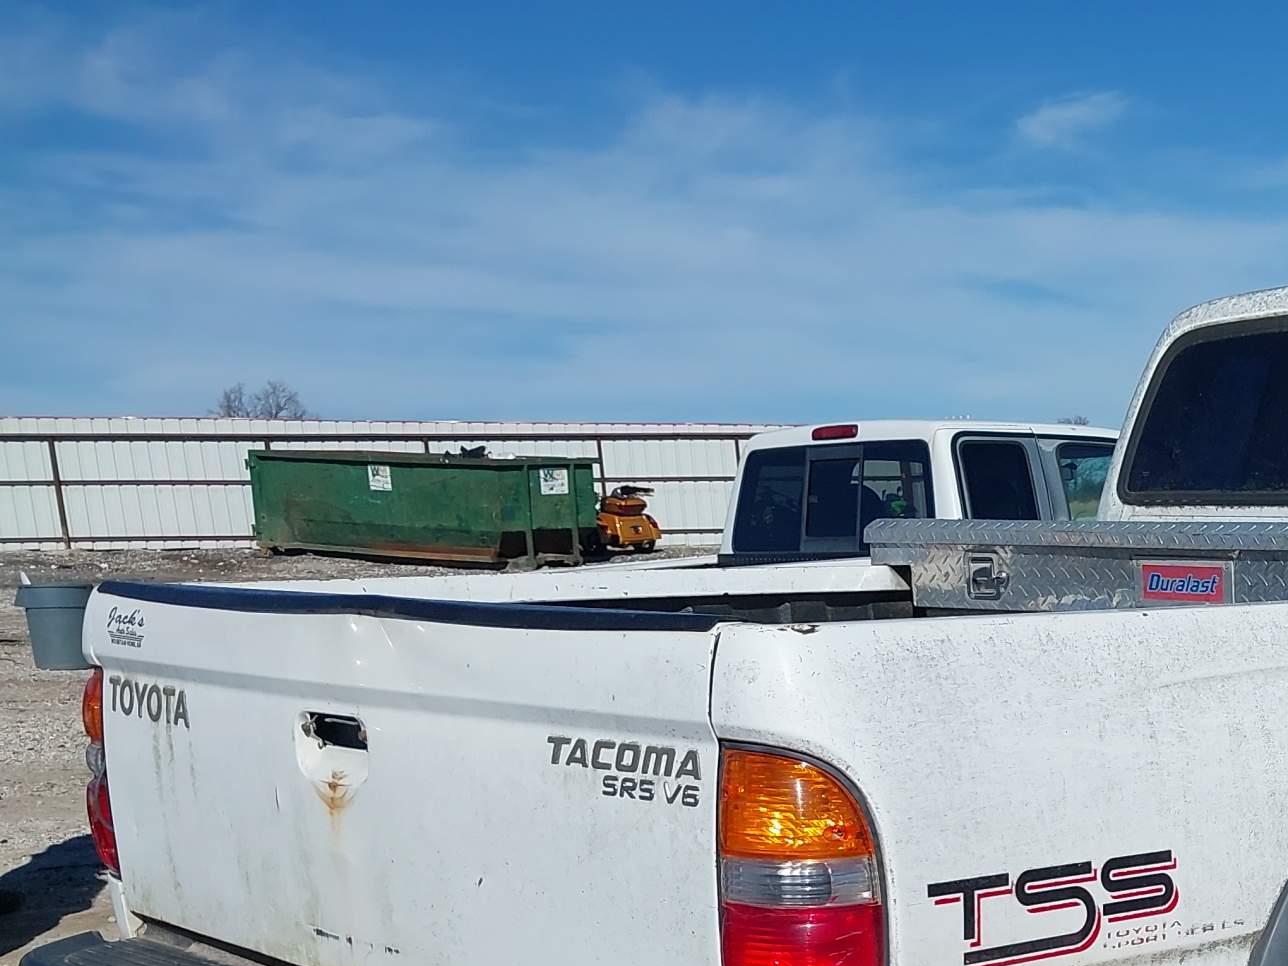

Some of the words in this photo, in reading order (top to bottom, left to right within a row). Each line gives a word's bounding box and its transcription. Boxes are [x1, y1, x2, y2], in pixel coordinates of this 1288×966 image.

[1147, 573, 1218, 595] Duralast
[107, 606, 145, 628] Jack's
[108, 675, 191, 729] TOYOTA
[547, 735, 702, 781] TACOMA
[663, 781, 702, 808] V6
